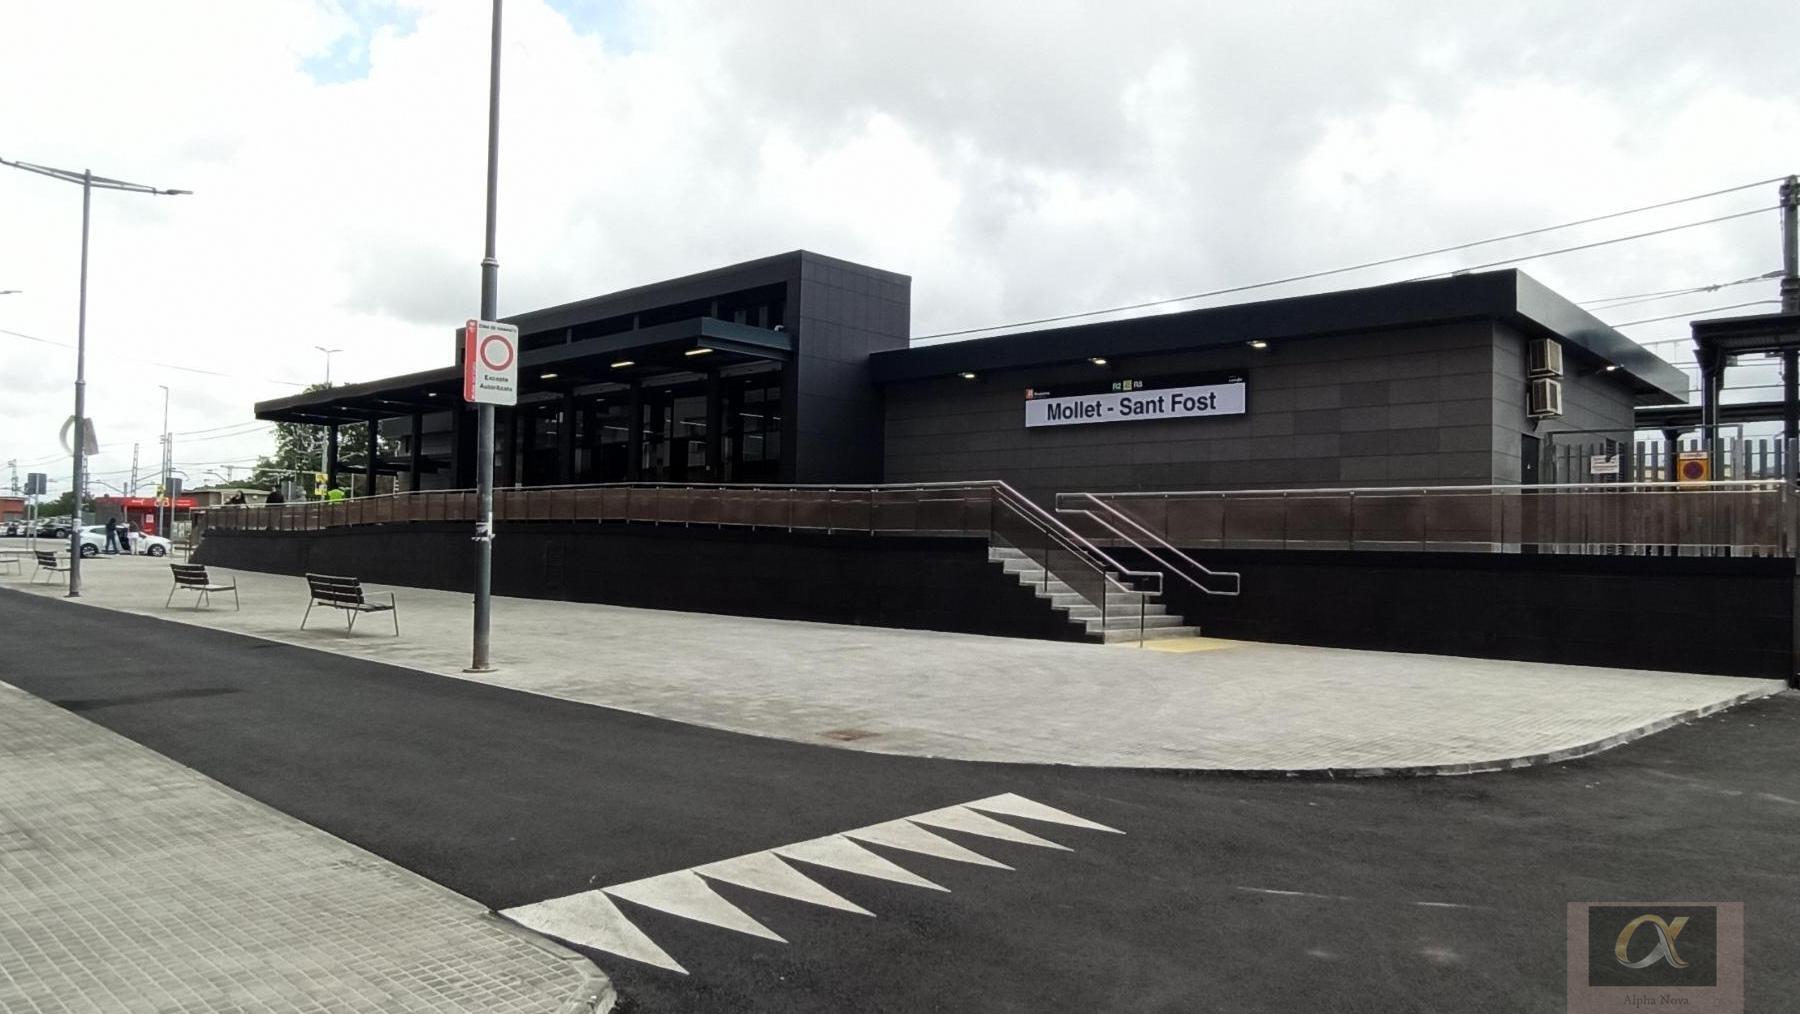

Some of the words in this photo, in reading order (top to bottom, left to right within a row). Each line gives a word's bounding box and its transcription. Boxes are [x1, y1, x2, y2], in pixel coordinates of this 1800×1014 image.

[1047, 401, 1102, 421] Mollet
[1119, 396, 1165, 416] Sant
[1171, 391, 1216, 413] Fost
